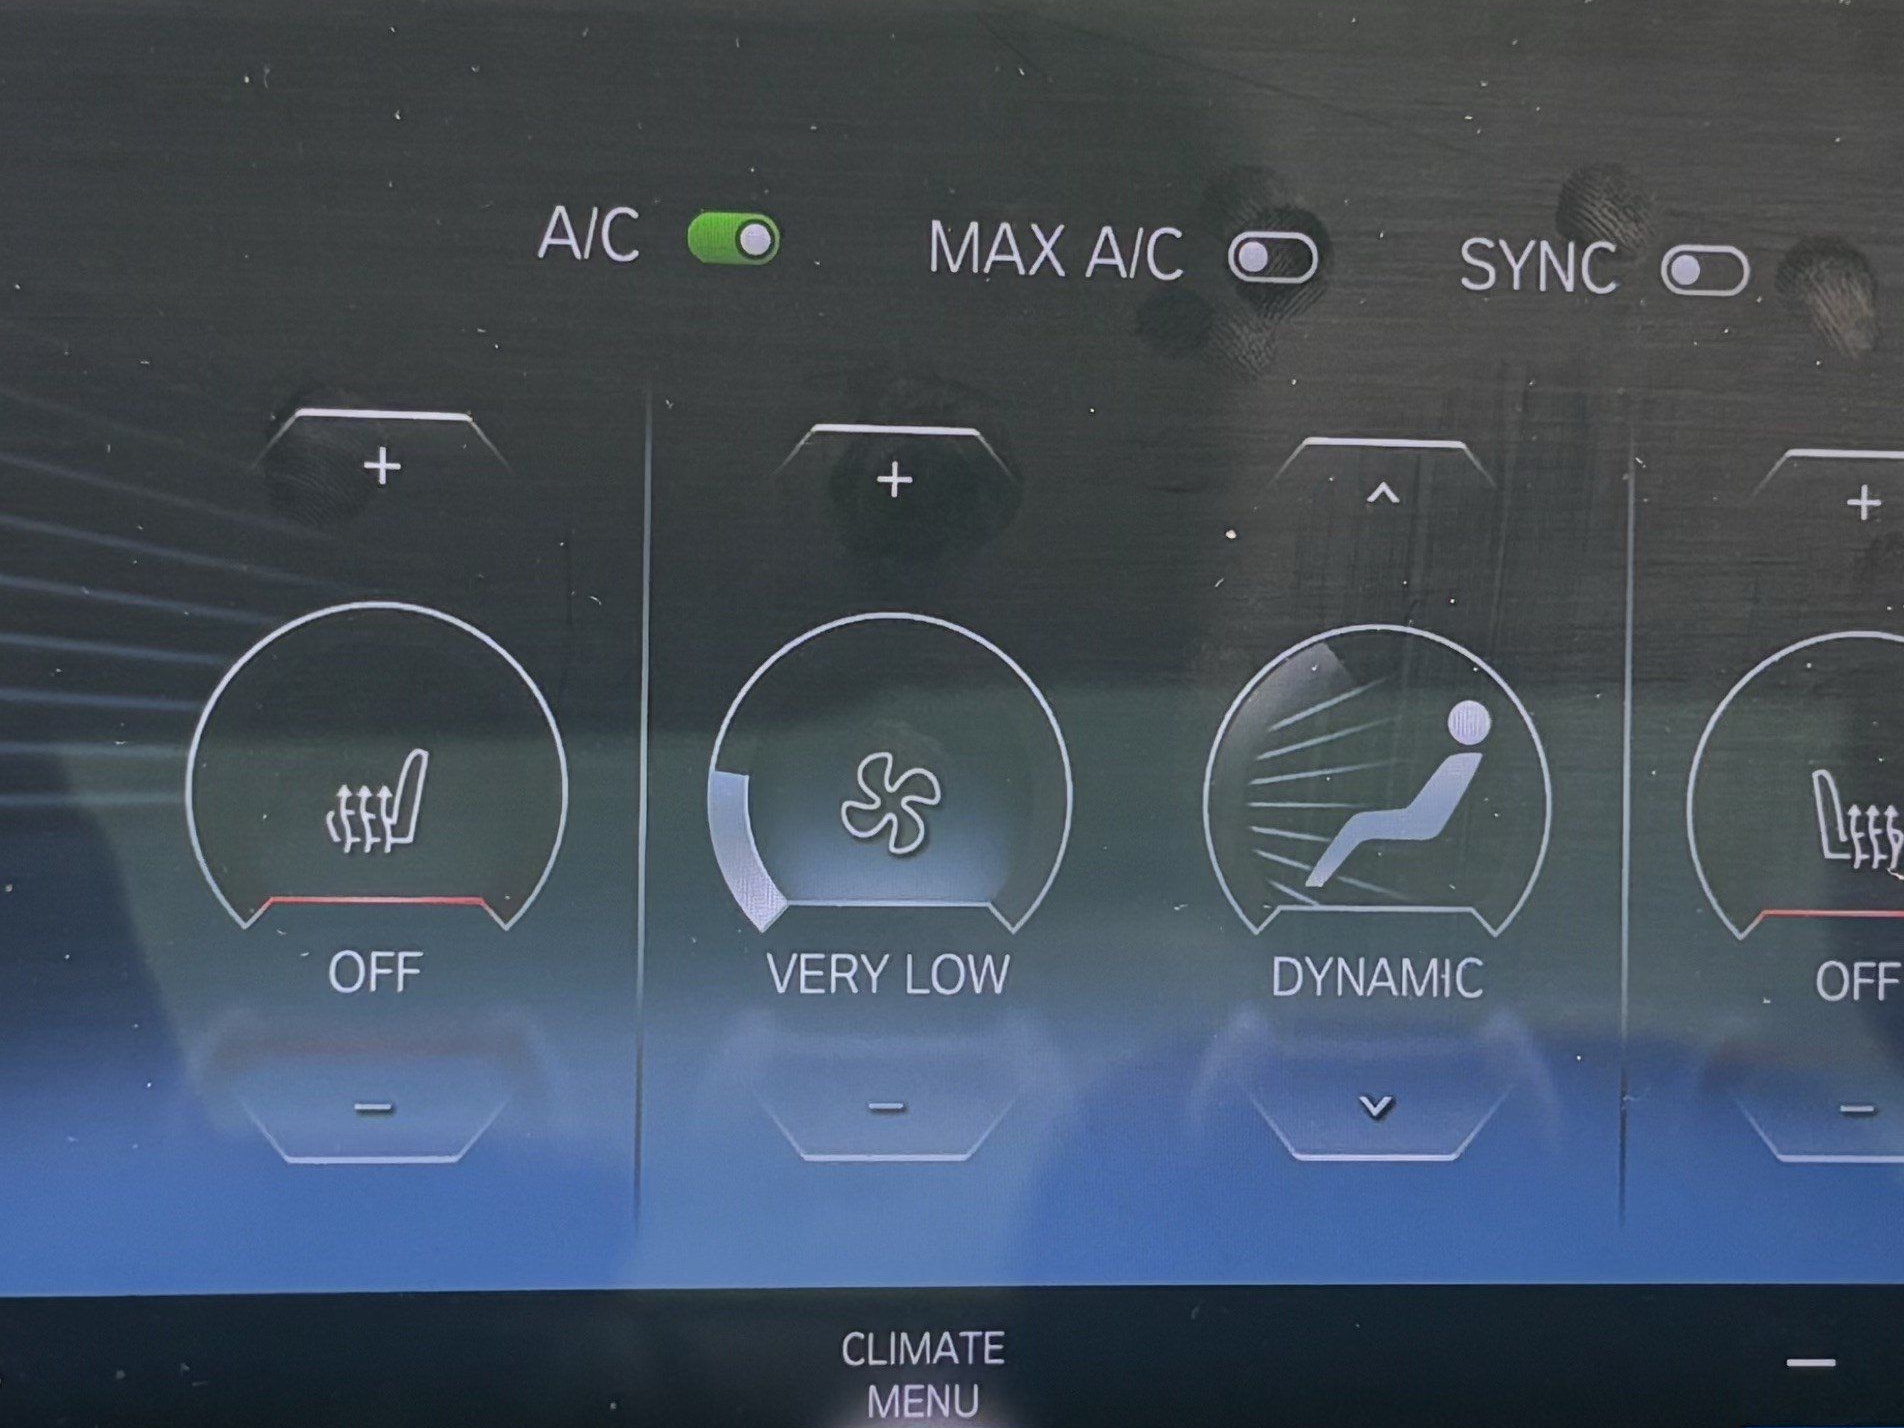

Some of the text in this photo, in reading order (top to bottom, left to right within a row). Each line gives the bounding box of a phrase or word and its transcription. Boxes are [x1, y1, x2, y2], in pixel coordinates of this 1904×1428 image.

[537, 206, 641, 266] A/C
[928, 218, 1186, 283] MAX A/C
[1458, 237, 1618, 297] SYNC
[328, 949, 425, 995] OFF
[767, 951, 1012, 998] VERY LOW
[1271, 954, 1485, 1000] DYNAMIC
[1815, 958, 1901, 1003] OFF
[842, 1331, 1005, 1367] CLIMATE
[868, 1384, 979, 1418] MENU
